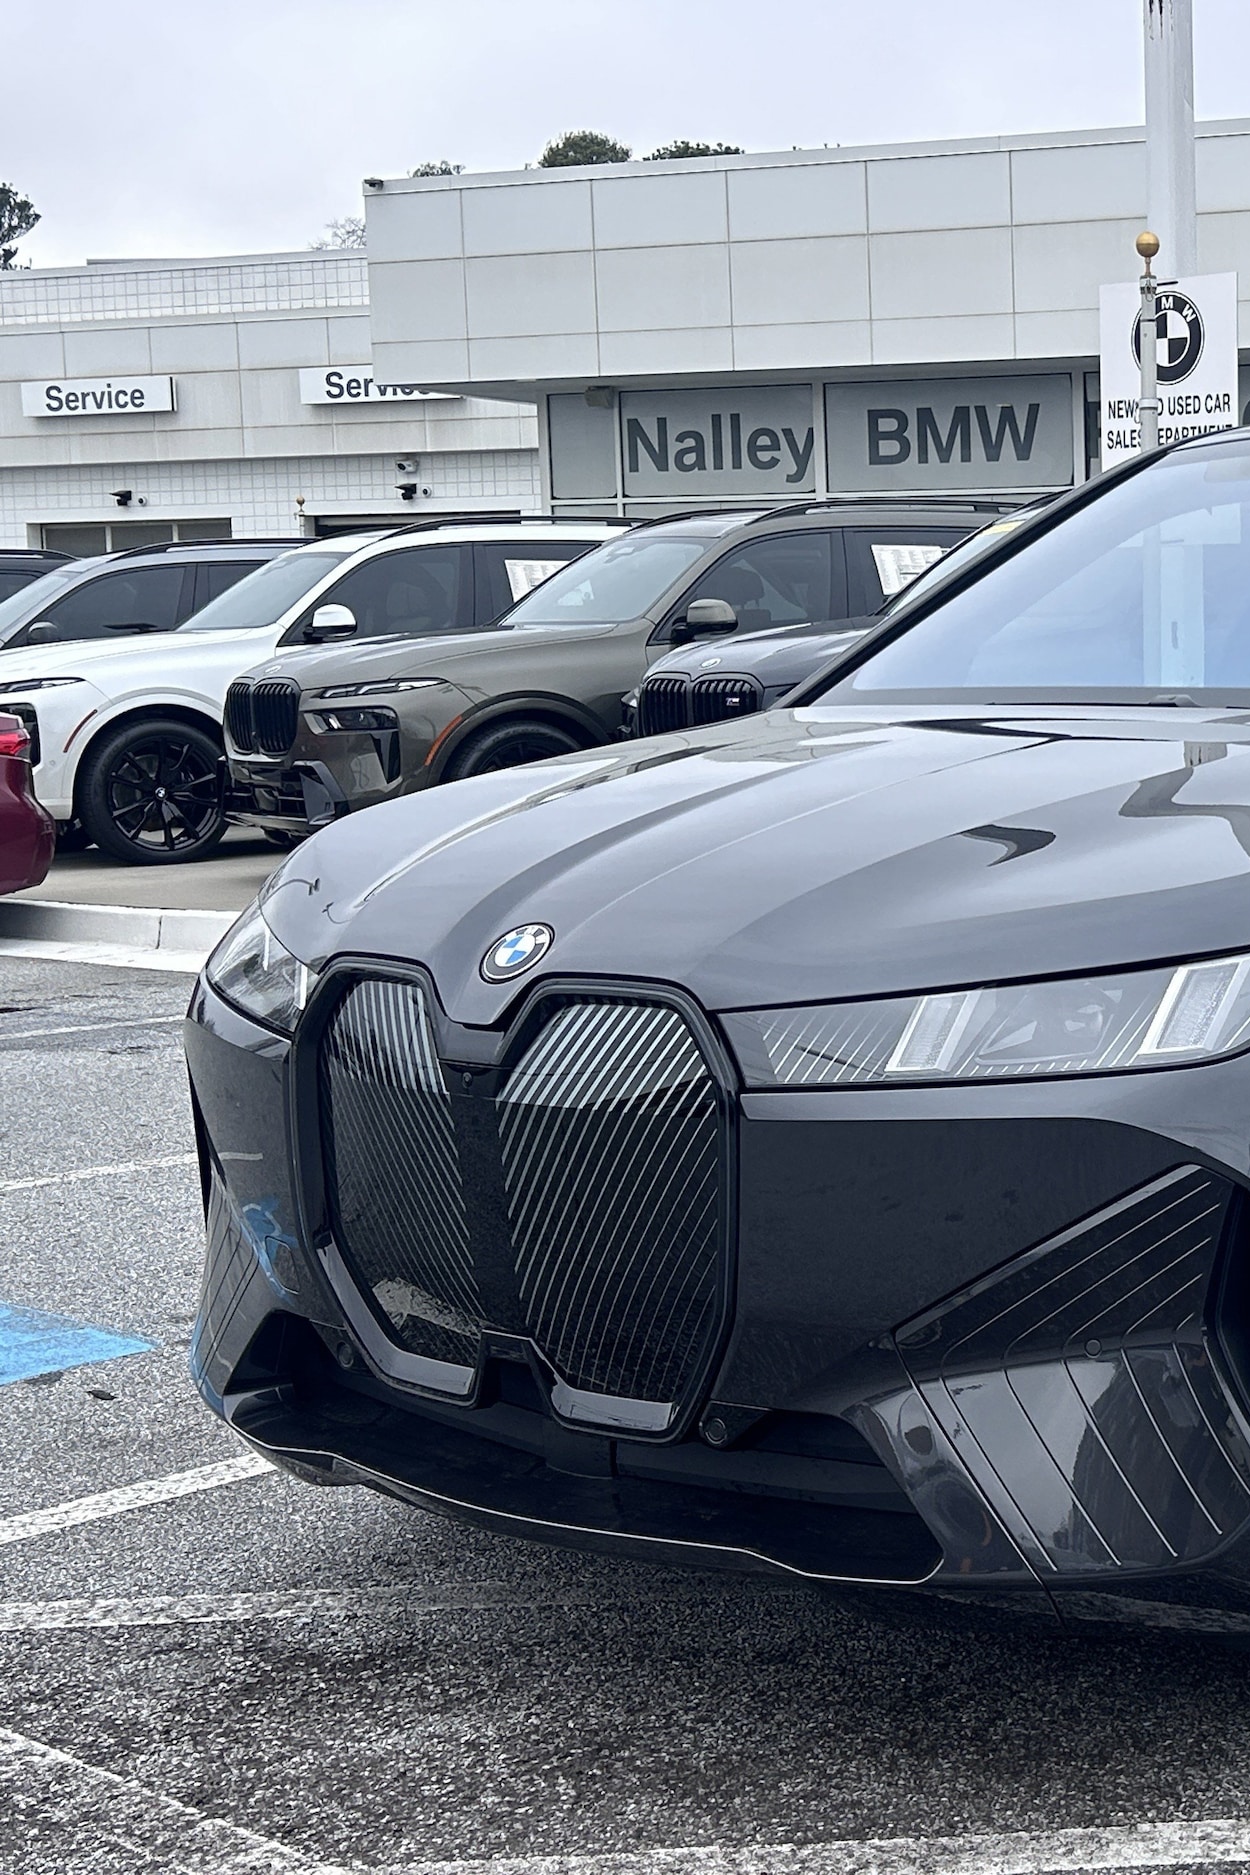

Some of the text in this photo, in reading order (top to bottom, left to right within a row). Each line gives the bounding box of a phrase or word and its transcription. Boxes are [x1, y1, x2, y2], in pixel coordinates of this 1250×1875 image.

[45, 382, 145, 413] Service
[1108, 398, 1135, 420] NEW
[1168, 395, 1201, 416] USED
[1204, 393, 1231, 414] CAR
[626, 412, 814, 484] Nalley
[866, 402, 1041, 467] BMW
